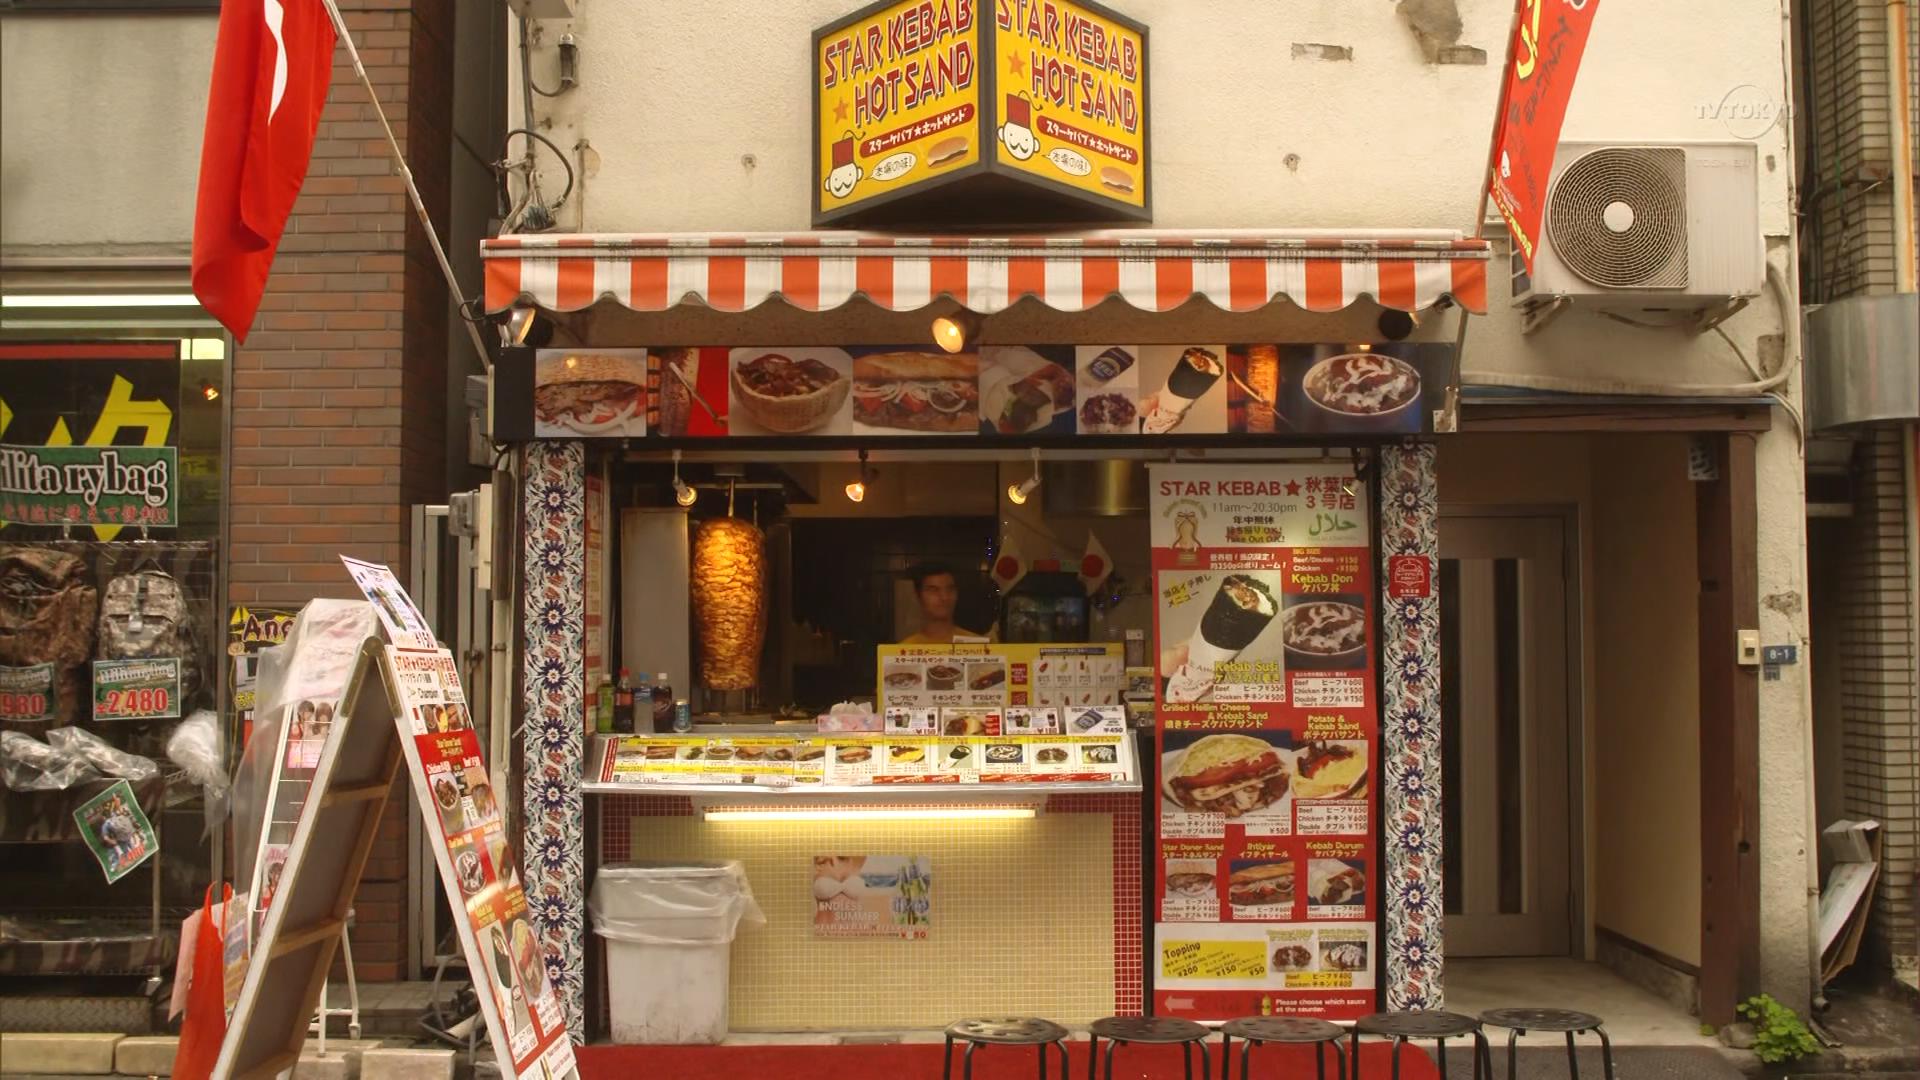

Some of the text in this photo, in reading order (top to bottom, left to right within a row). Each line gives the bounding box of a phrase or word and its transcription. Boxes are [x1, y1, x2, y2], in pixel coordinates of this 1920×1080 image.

[823, 0, 974, 90] STAR KEBAB
[996, 0, 1137, 82] STAR KEBAB
[854, 40, 974, 127] HOT SAND
[1031, 49, 1136, 133] HOT SAND
[1160, 481, 1281, 497] STAR KEBAB
[1249, 535, 1264, 543] Out
[1291, 573, 1353, 584] Kebab Don
[1214, 661, 1251, 672] Kebab
[1162, 703, 1190, 712] Grilled
[1219, 703, 1252, 712] Cheese
[1217, 712, 1245, 720] Kebab
[1247, 712, 1268, 720] Sand
[1337, 715, 1345, 723] &
[1305, 842, 1334, 850] Kebab
[834, 911, 880, 921] SUMMER
[1164, 942, 1201, 960] Topping
